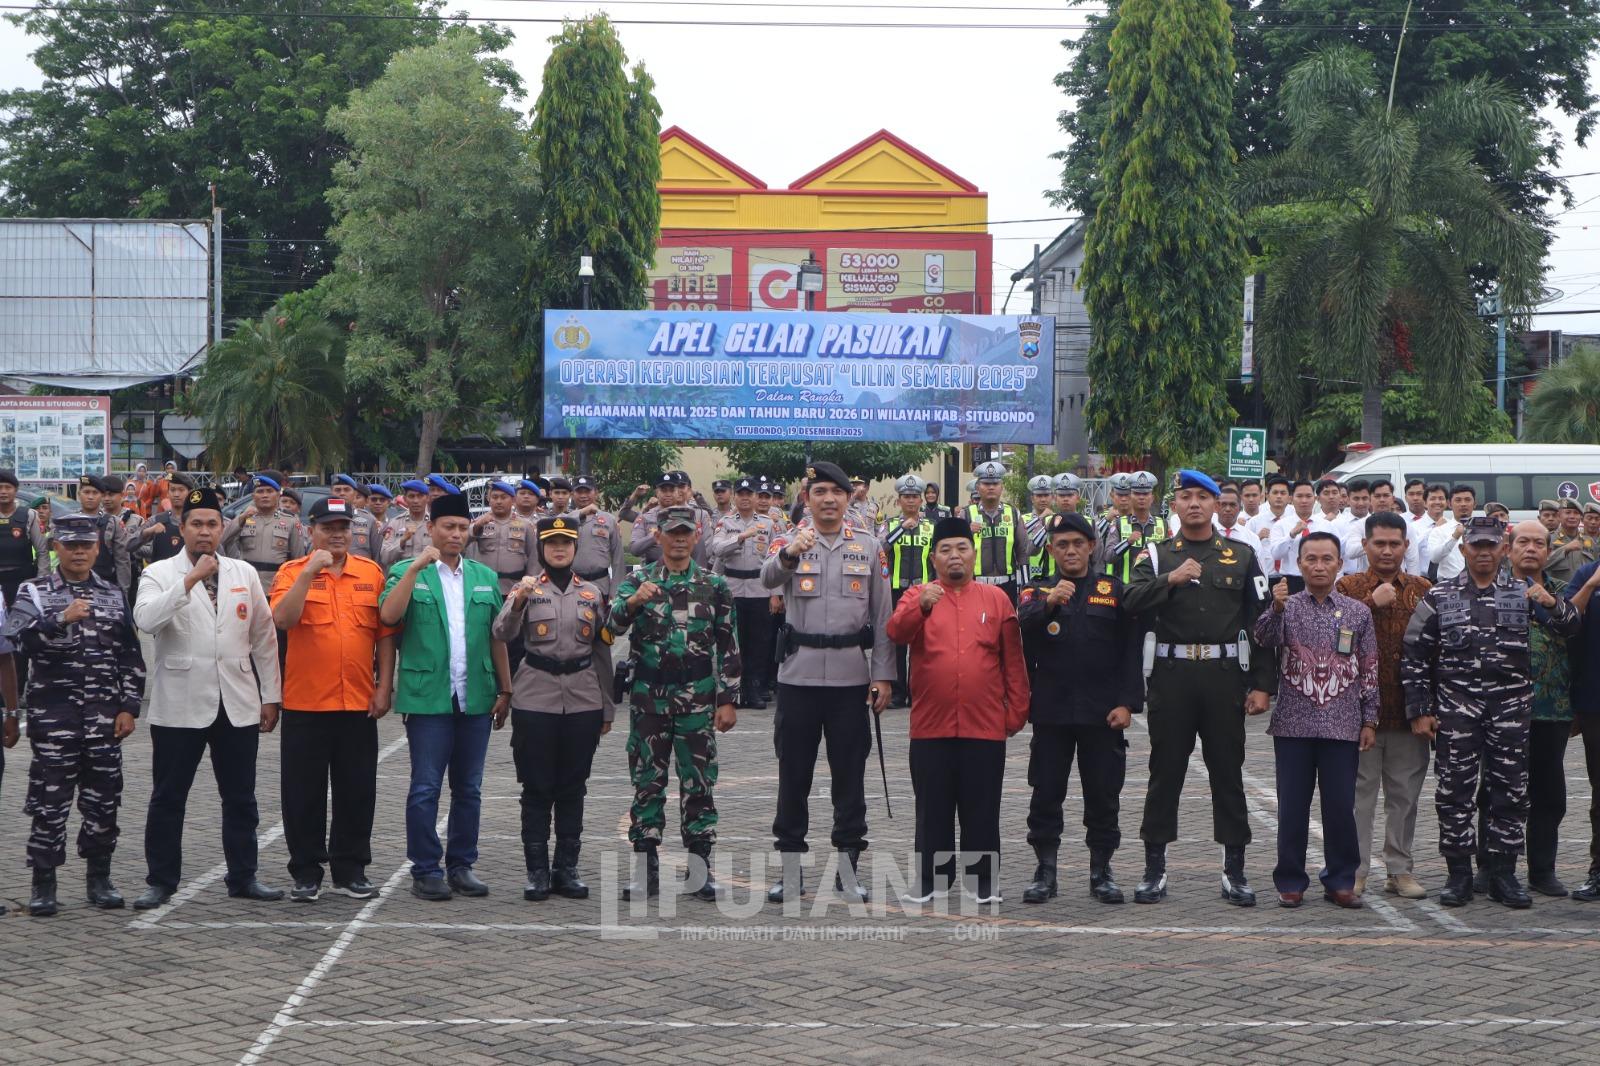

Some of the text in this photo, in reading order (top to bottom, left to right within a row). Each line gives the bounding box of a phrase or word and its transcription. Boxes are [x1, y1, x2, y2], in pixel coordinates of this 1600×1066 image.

[841, 254, 898, 267] 53.000
[840, 274, 898, 283] KELULUSAN
[844, 284, 895, 293] SISWA GO
[923, 296, 945, 307] GO
[648, 322, 714, 355] APEL
[724, 322, 812, 357] GELAR
[818, 323, 949, 358] PASUKAN
[560, 360, 635, 385] OPERASI
[640, 360, 744, 386] KEPOLISIAN
[748, 360, 835, 388] TERPUSAT
[901, 364, 974, 389] SEMERU
[755, 389, 843, 404] Dalam Rangka
[561, 405, 1035, 423] PENGAMANAN NATAL 2025 DAN TAHUN BARU 2026 DI WILAYAH KAB. SITUBONDO
[788, 427, 797, 435] 19
[798, 427, 842, 436] DESEMBER
[842, 427, 863, 436] 2025
